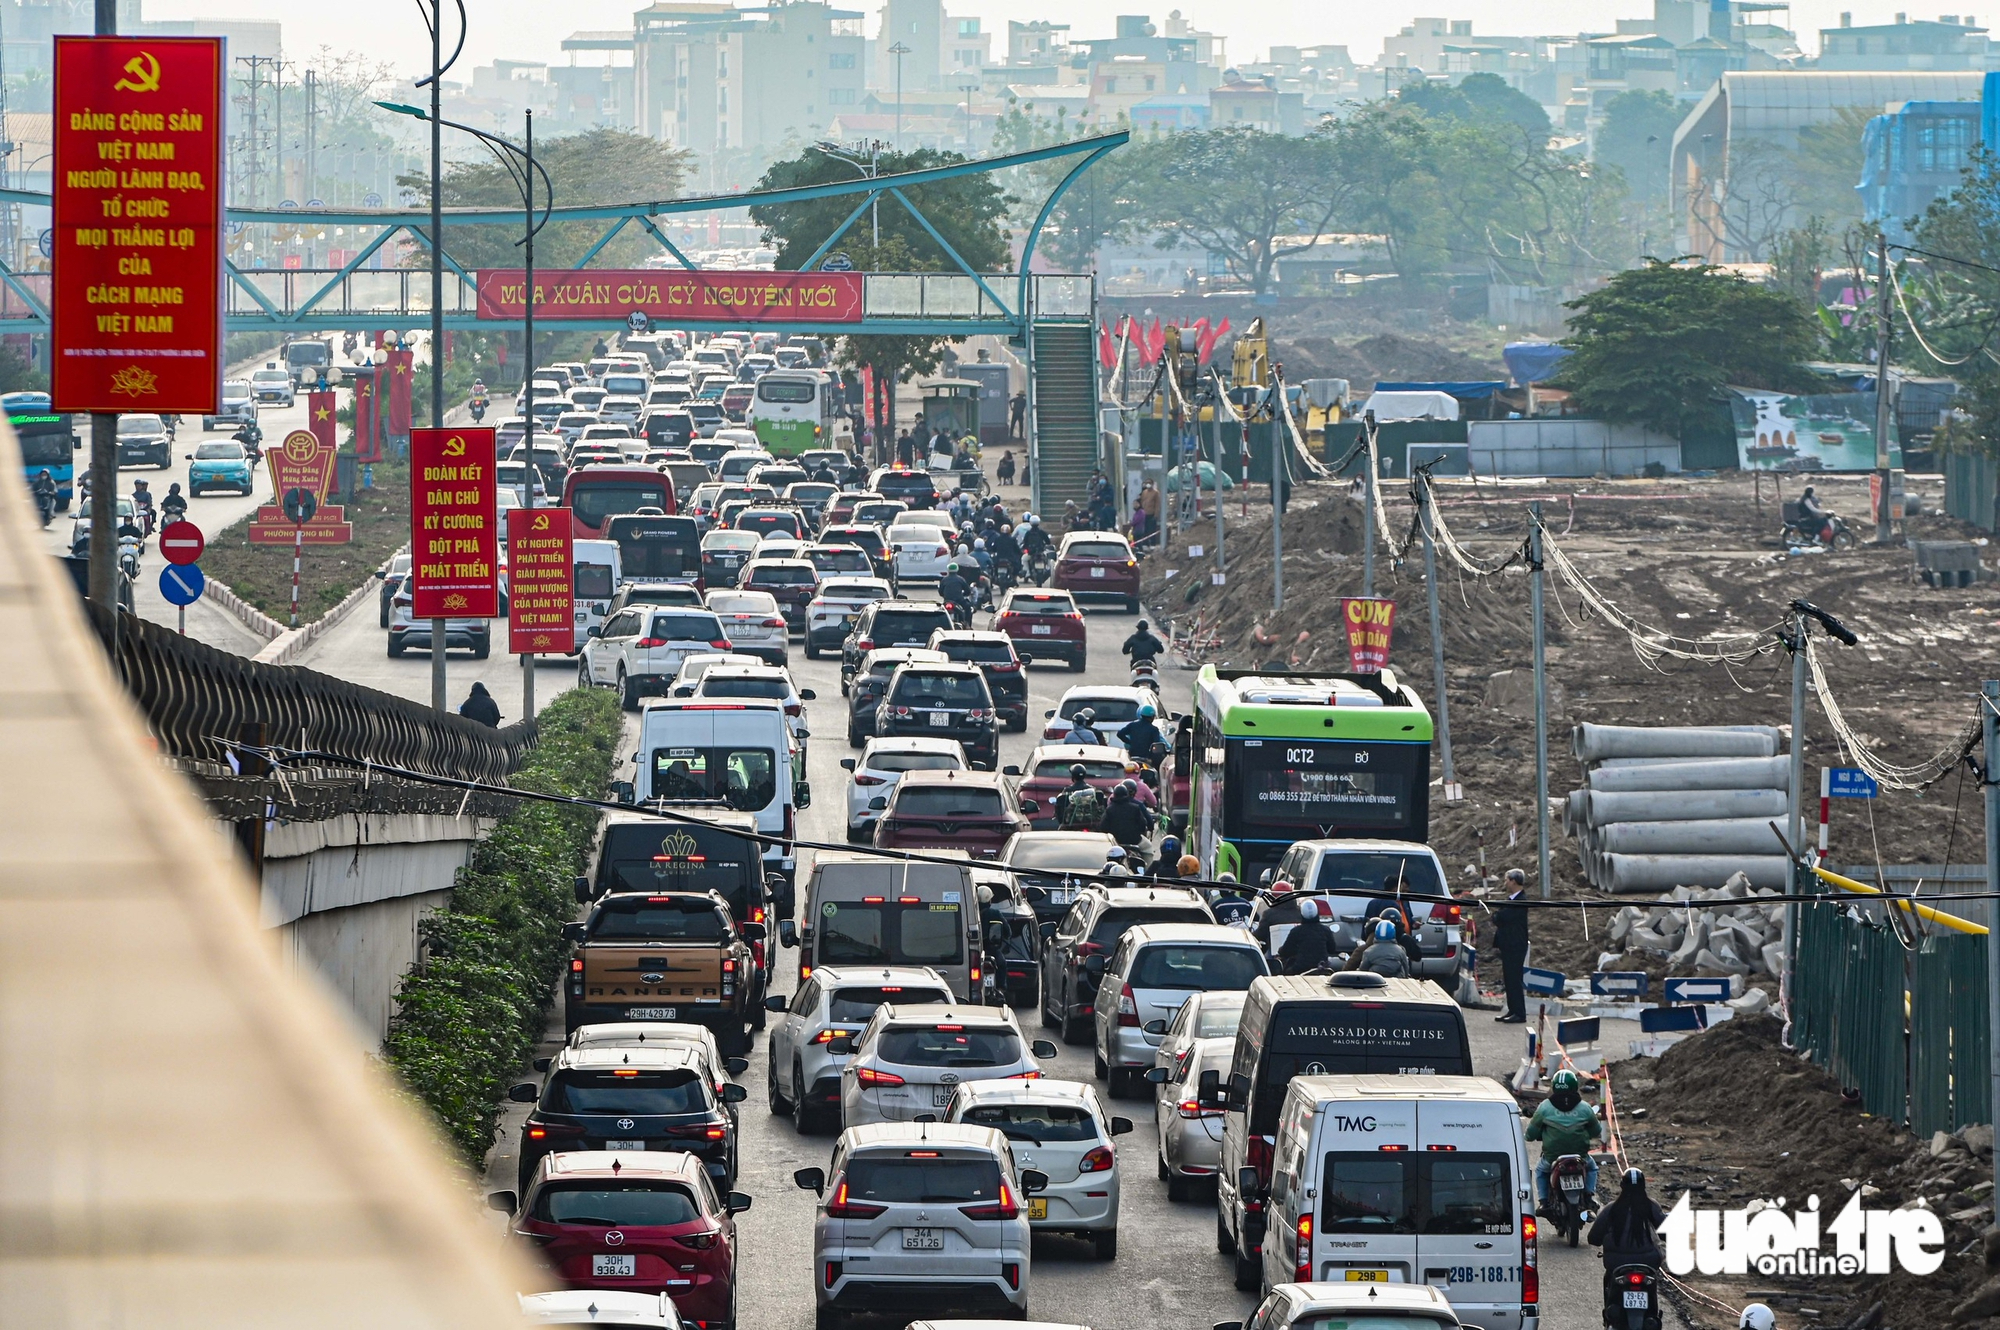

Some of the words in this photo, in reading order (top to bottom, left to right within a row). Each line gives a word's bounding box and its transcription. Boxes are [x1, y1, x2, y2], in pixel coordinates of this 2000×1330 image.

[70, 107, 116, 131] ĐẢNG
[119, 109, 165, 135] CỘNG
[168, 107, 203, 131] SẢN
[98, 138, 133, 163] VIỆT
[136, 142, 175, 160] NAM
[67, 167, 118, 189] NGƯỜI
[121, 167, 164, 189] LÃNH
[167, 171, 206, 193] ĐẠO,
[101, 193, 123, 217] TỔ
[126, 196, 170, 218] CHỨC
[76, 228, 108, 250] MỌI
[112, 222, 165, 247] THẮNG
[169, 228, 195, 250] LỢI
[118, 252, 152, 276] CỦA
[86, 283, 131, 304] CÁCH
[134, 286, 184, 308] MẠNG
[500, 280, 547, 305] MÙA
[552, 281, 610, 305] XUÂN
[616, 279, 662, 305] CỦA
[668, 280, 697, 305] KỶ
[703, 283, 792, 307] NGUYÊN
[799, 283, 838, 308] MỚI
[96, 311, 131, 337] VIỆT
[135, 315, 173, 333] NAM
[423, 466, 457, 481] ĐOÀN
[460, 462, 482, 481] KẾT
[427, 489, 453, 505] DÂN
[455, 487, 480, 505] CHỦ
[423, 511, 439, 530] KỶ
[442, 514, 484, 530] CƯƠNG
[428, 537, 452, 557] ĐỘT
[455, 536, 480, 553] PHÁ
[516, 536, 528, 549] KỶ
[530, 537, 564, 549] NGUYÊN
[516, 552, 538, 564] PHÁT
[540, 550, 565, 563] TRIỂN
[420, 562, 451, 578] PHÁT
[453, 557, 489, 578] TRIỂN
[516, 567, 536, 579] GIÀU
[513, 584, 538, 596] THỊNH
[540, 583, 568, 596] VƯỢNG
[513, 597, 531, 609] CỦA
[532, 597, 551, 608] DÂN
[552, 597, 569, 610] TỘC
[519, 612, 538, 625] VIỆT
[540, 613, 563, 623] NAM!
[1348, 599, 1393, 626] CƠM
[1367, 630, 1388, 648] DÂN
[1355, 750, 1369, 763] BỜ
[1258, 792, 1269, 803] GỌI
[1269, 791, 1286, 801] 0866
[1286, 791, 1299, 801] 355
[1299, 792, 1312, 802] 222
[1331, 794, 1348, 803] THÀNH
[1349, 795, 1365, 803] NHÂN
[1365, 795, 1377, 803] VIÊN
[1377, 796, 1397, 804] VINBUS
[649, 861, 662, 869] LA
[665, 861, 705, 870] REGINA
[589, 987, 717, 996] RANGER
[1287, 1026, 1387, 1038] AMBASSADOR
[1392, 1028, 1445, 1040] CRUISE
[1398, 1067, 1406, 1075] XE
[1334, 1116, 1377, 1132] TMG
[616, 1141, 634, 1150] 30H
[913, 1228, 932, 1238] 34A
[1485, 1224, 1491, 1233] XE
[906, 1238, 939, 1248] 651.26
[604, 1256, 623, 1265] 30H
[597, 1266, 631, 1275] 938.43
[1357, 1271, 1376, 1281] 29B
[1449, 1266, 1522, 1283] 29B-188.11
